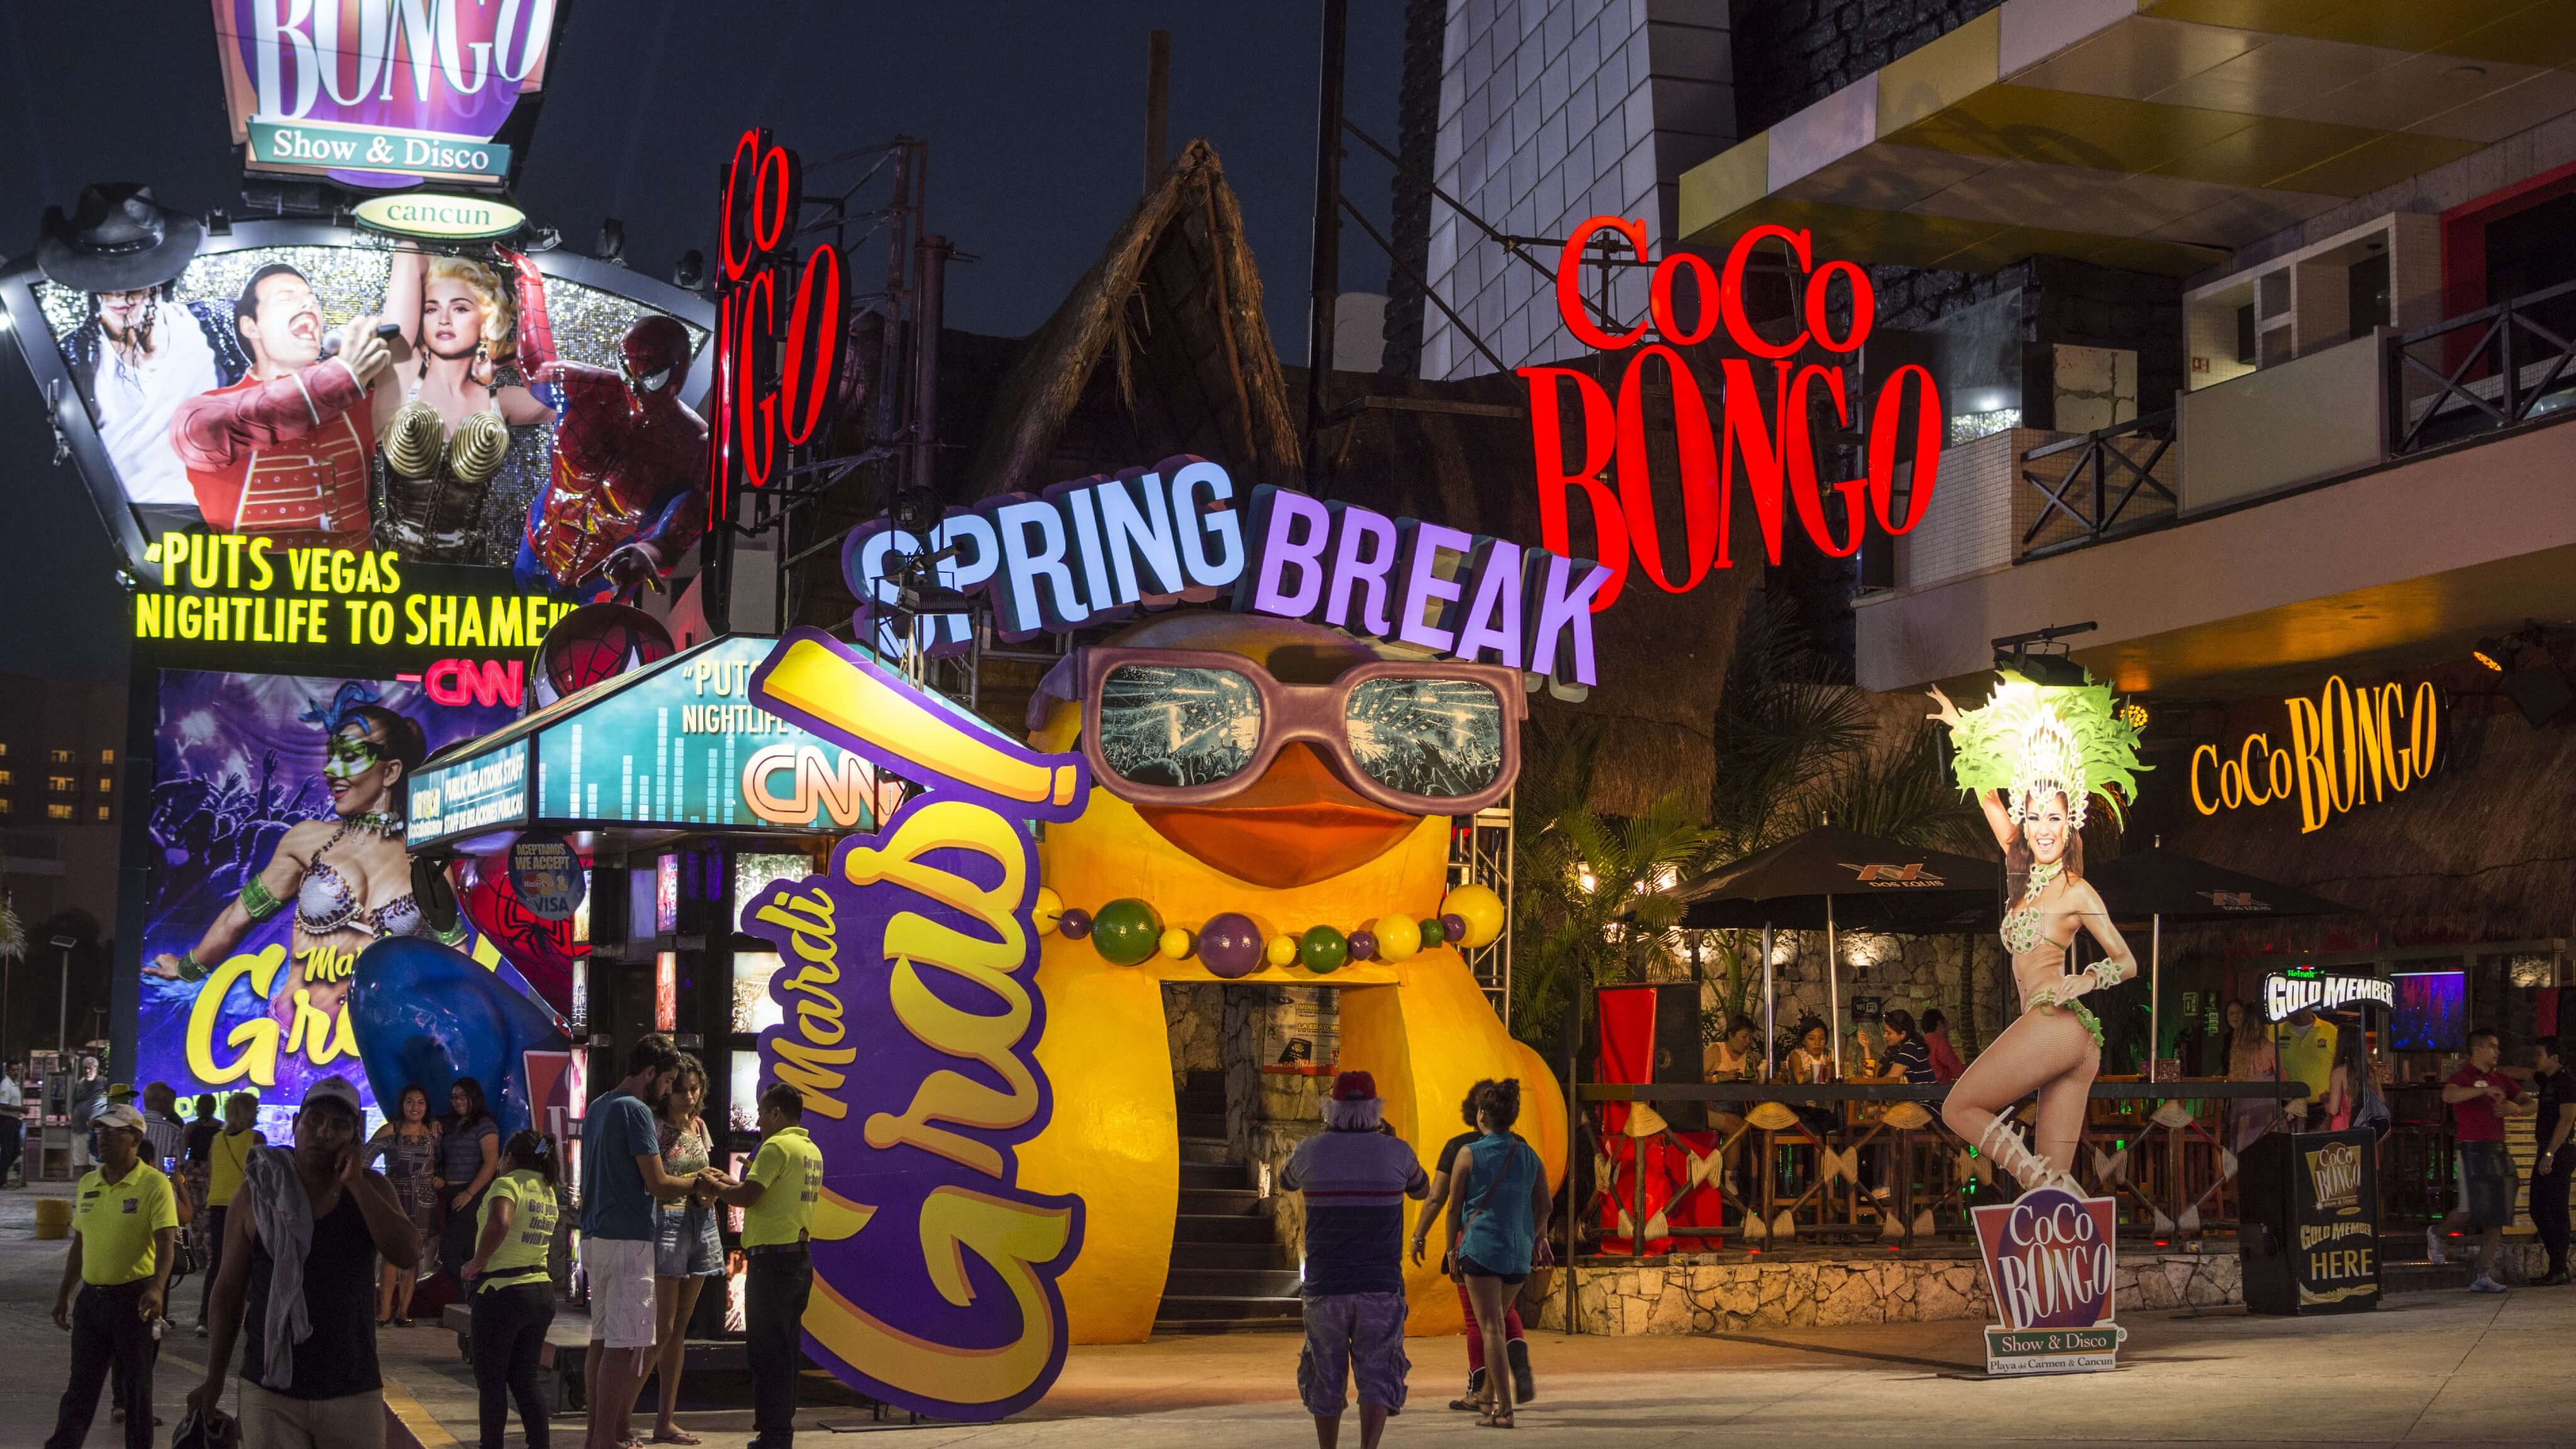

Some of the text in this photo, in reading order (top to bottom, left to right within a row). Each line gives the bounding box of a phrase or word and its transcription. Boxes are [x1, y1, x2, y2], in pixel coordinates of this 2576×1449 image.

[252, 0, 553, 123] BONGO
[274, 129, 489, 170] Show & Disco
[387, 204, 491, 226] cancun
[1517, 345, 1941, 613] BONGO
[289, 547, 401, 594] VEGAS
[862, 461, 1614, 686] SPRING BREAK
[136, 593, 329, 644] NIGHTLIFE
[346, 600, 395, 646] TO
[502, 752, 525, 786] STAFF
[2284, 675, 2436, 834] BONGO
[742, 744, 904, 825] CNN
[515, 856, 570, 870] WE ACCEPT
[516, 843, 566, 856] ACEPTAMOS
[535, 897, 569, 912] VISA
[757, 887, 857, 1119] Mardi
[2268, 976, 2394, 1021] GOLD MEMBER
[2315, 1163, 2361, 1202] BONGO
[529, 1199, 543, 1213] Get
[2300, 1222, 2372, 1250] GOLD MEMBER
[2311, 1248, 2374, 1280] HERE
[1998, 1243, 2111, 1331] BONGO
[2002, 1333, 2107, 1352] Show & Disco
[1990, 1360, 2016, 1374] Playa
[2028, 1358, 2066, 1368] Carmen
[2068, 1359, 2075, 1367] &
[2077, 1357, 2113, 1367] Cancun
